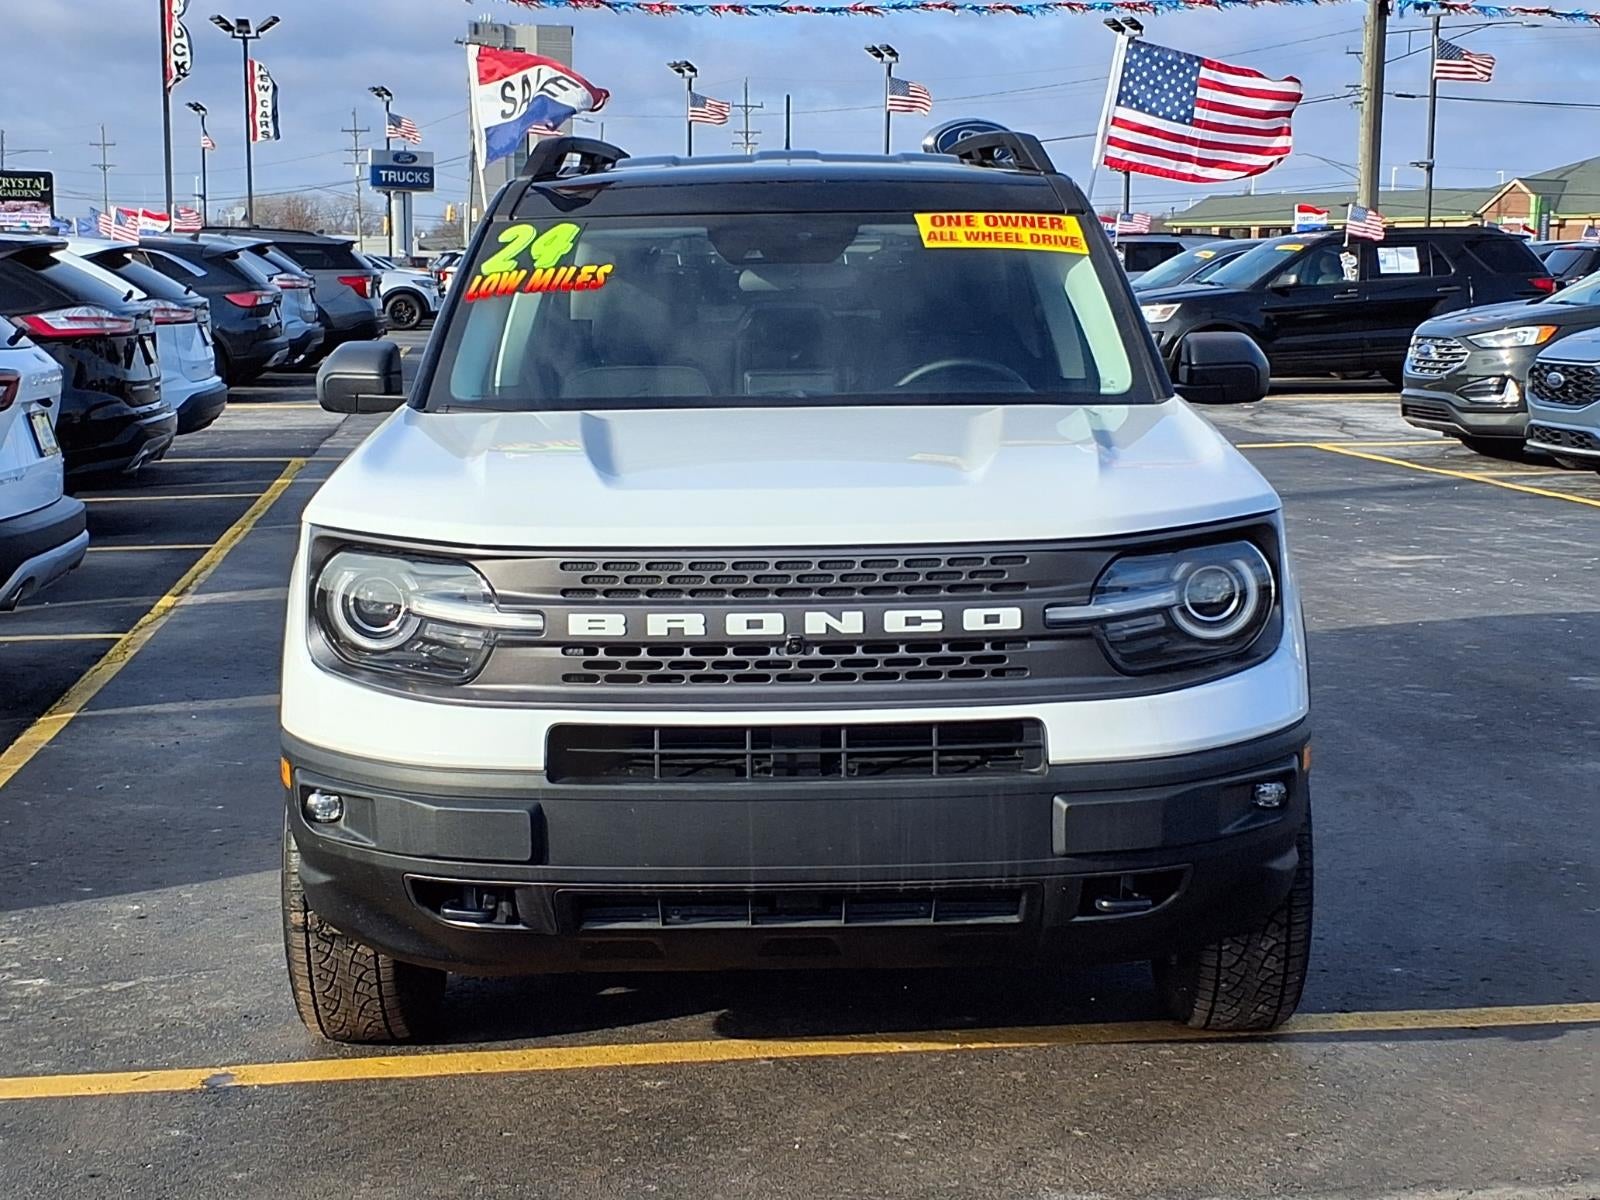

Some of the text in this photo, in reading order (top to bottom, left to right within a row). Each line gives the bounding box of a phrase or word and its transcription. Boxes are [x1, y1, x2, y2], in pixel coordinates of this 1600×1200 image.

[257, 64, 271, 139] NEW CARS
[501, 67, 581, 119] SALE
[379, 170, 431, 184] TRUCKS
[926, 231, 1082, 249] ALL WHEEL DRIVE
[930, 214, 1064, 231] ONE OWNER
[481, 223, 581, 276] 24
[464, 264, 614, 303] LOW MILES
[567, 606, 1023, 637] BRONCO
